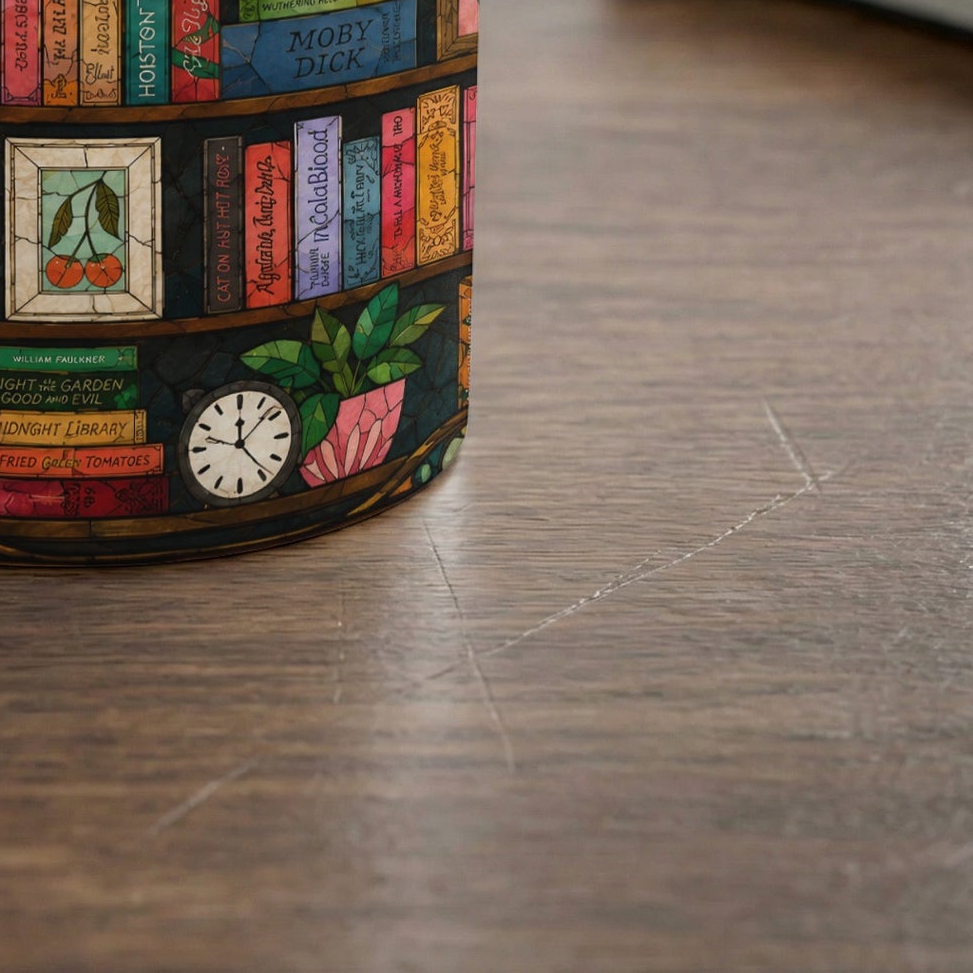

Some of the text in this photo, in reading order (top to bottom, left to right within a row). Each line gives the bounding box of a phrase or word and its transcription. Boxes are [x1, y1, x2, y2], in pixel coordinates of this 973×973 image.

[286, 19, 374, 53] MOBY
[294, 47, 366, 78] DICK
[216, 254, 231, 273] ON
[216, 276, 232, 303] CAT
[12, 354, 106, 364] WILLIAM FAULKNER
[60, 378, 124, 392] GARDEN
[1, 392, 43, 405] GOOD
[72, 393, 103, 406] EVIL
[85, 453, 150, 469] TOMATOES
